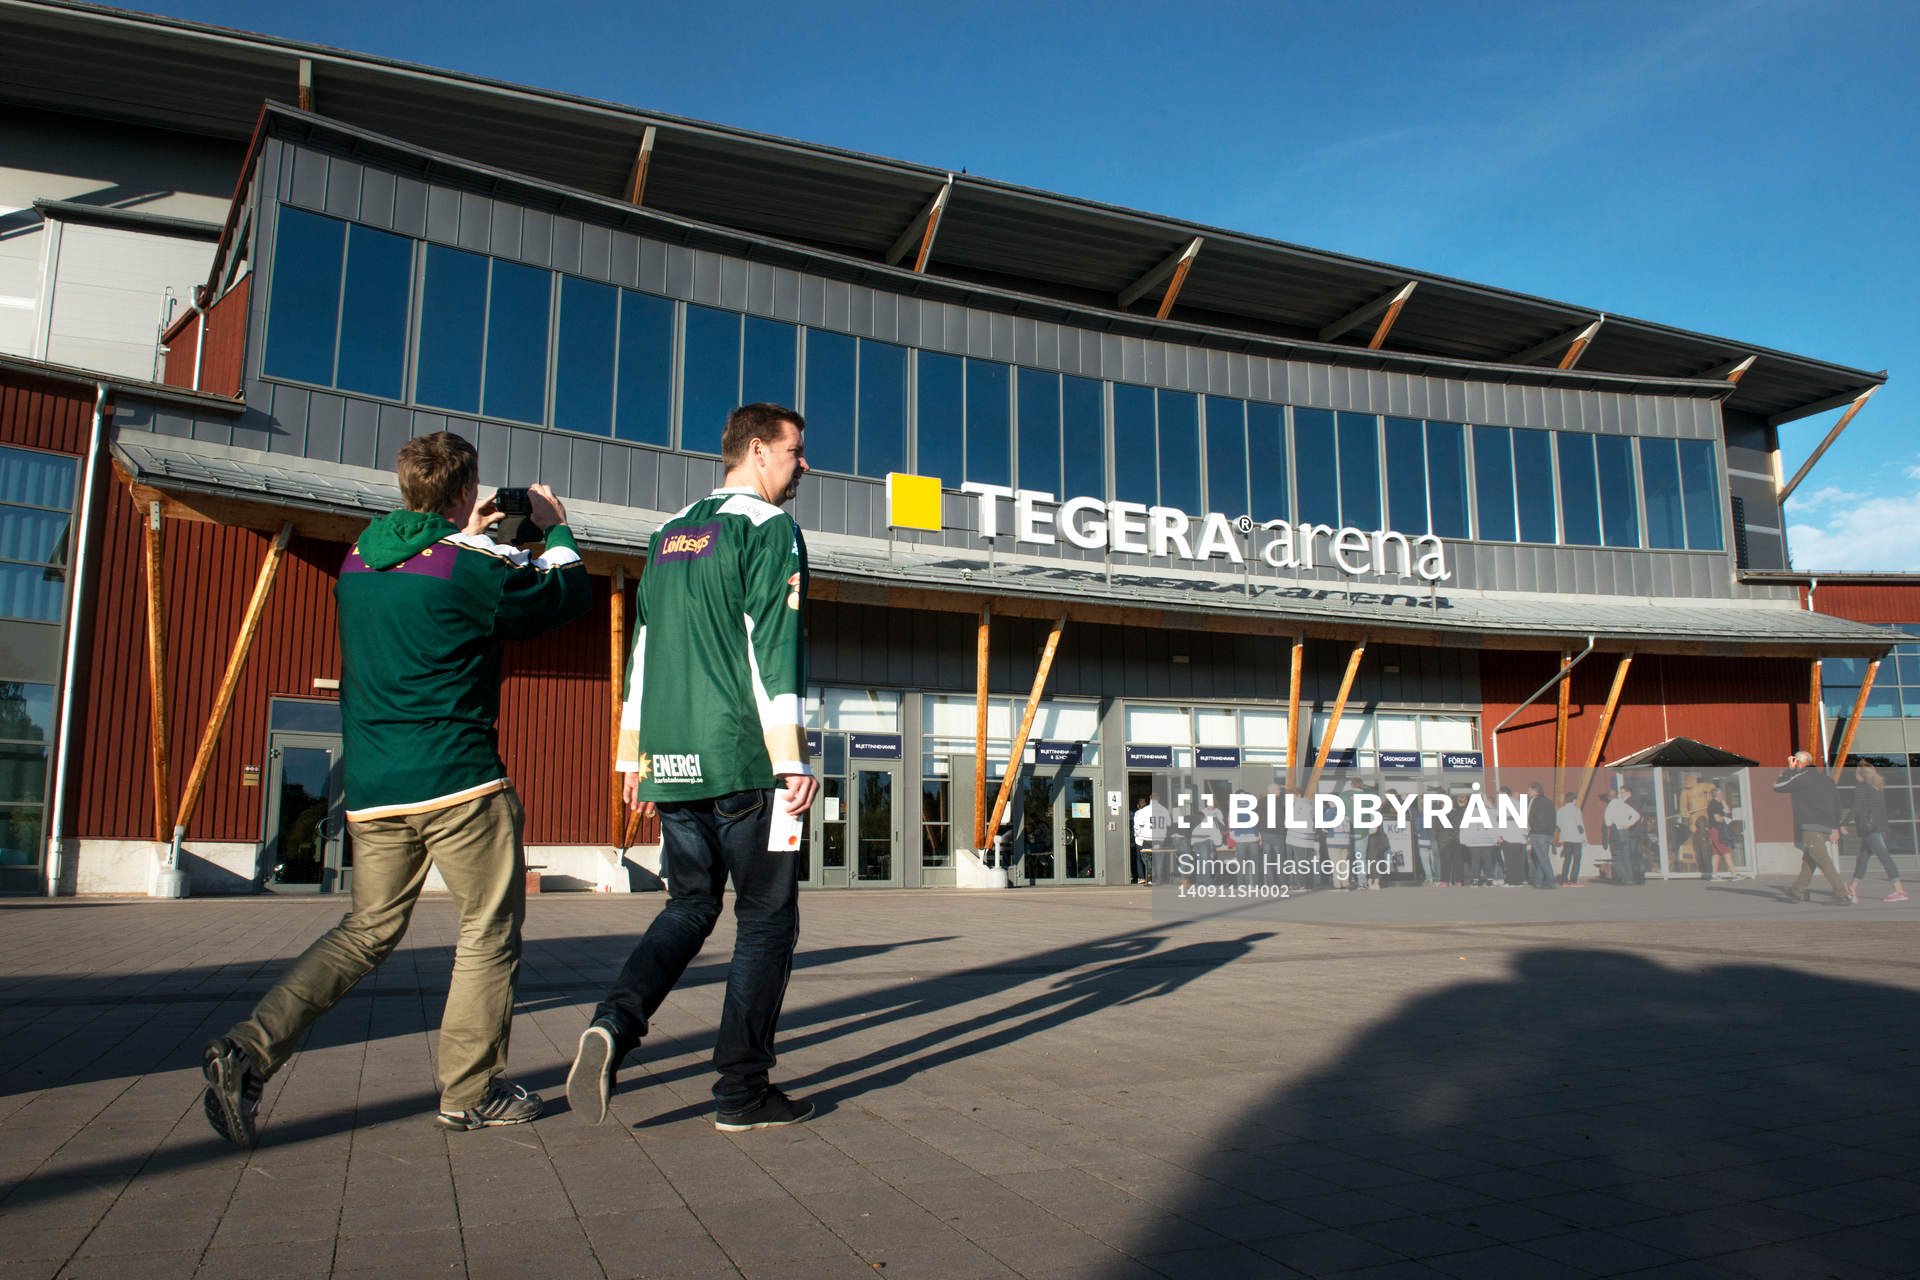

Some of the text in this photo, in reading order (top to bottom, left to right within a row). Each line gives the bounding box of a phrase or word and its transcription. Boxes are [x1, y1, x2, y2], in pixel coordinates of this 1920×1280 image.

[662, 534, 711, 555] Löfbergs
[1260, 518, 1452, 582] arena
[652, 754, 702, 777] ENERGI
[1447, 756, 1477, 765] FÖRETAG
